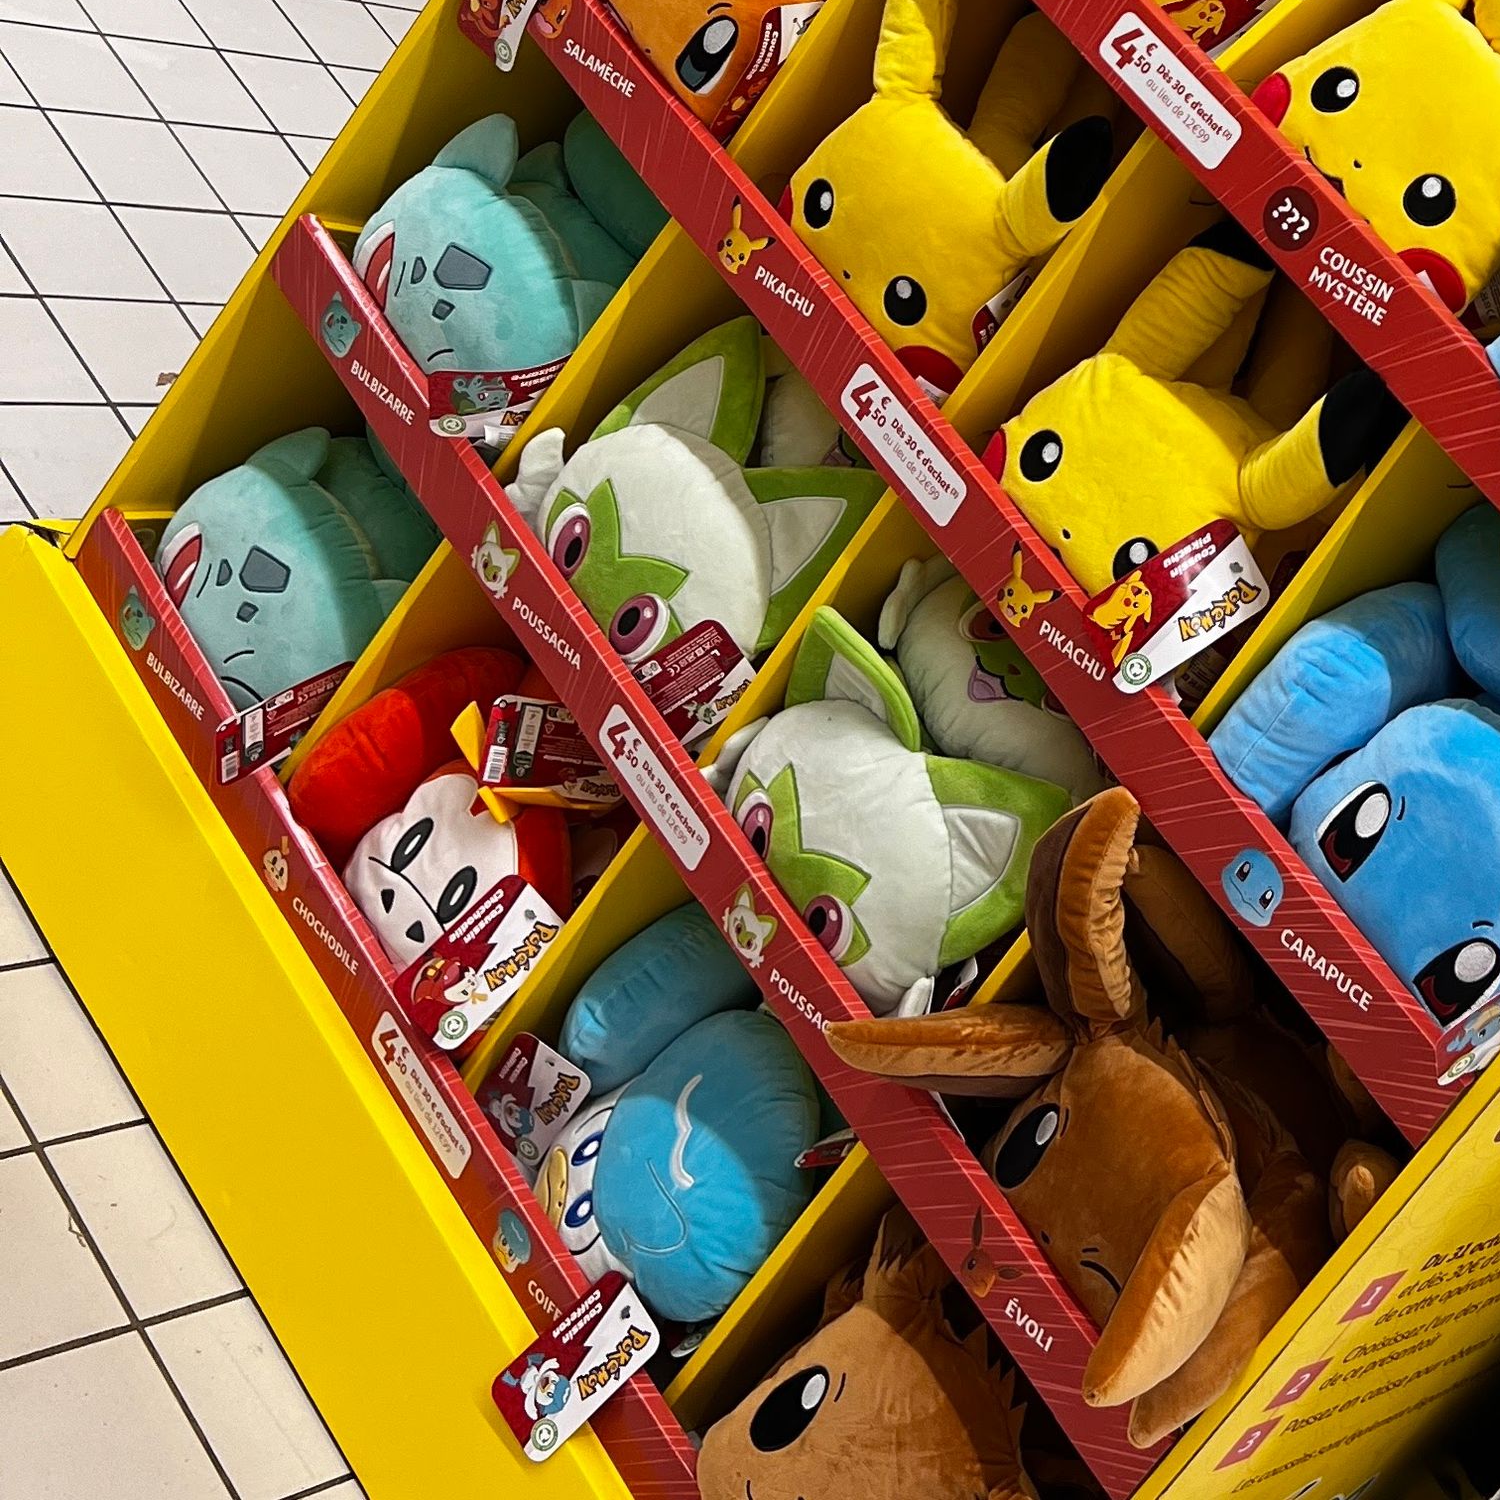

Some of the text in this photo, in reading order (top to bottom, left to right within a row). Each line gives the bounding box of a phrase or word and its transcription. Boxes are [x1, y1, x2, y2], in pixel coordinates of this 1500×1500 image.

[562, 39, 637, 100] SALAMÈCHE
[1156, 64, 1223, 136] Dès 30 d'achat
[1146, 79, 1210, 143] au lieu de 12€99
[1270, 197, 1312, 241] ???
[754, 265, 816, 318] PIKACHU
[1308, 267, 1389, 328] MYSTÈRE
[1319, 246, 1396, 304] COUSSIN
[350, 358, 416, 427] BULBIZARRE
[882, 432, 941, 501] au lieu de 12€99
[891, 418, 951, 494] Dès 30 d'achat
[511, 596, 583, 672] POUSSACHA
[1038, 619, 1107, 682] PIKACHU
[145, 651, 205, 722] BULBIZARRE
[642, 760, 656, 782] Dès
[654, 778, 666, 795] 30
[670, 801, 697, 839] d'achat
[292, 896, 360, 977] CHOCHODILE
[1279, 927, 1374, 1013] CARAPUCE
[1420, 1251, 1447, 1271] Du
[1447, 1242, 1473, 1261] 31
[527, 1279, 564, 1322] COIFF
[1004, 1297, 1055, 1353] ÉVOLI
[1361, 1285, 1382, 1308] 1
[1286, 1373, 1311, 1396] 2
[1237, 1430, 1261, 1453] 3
